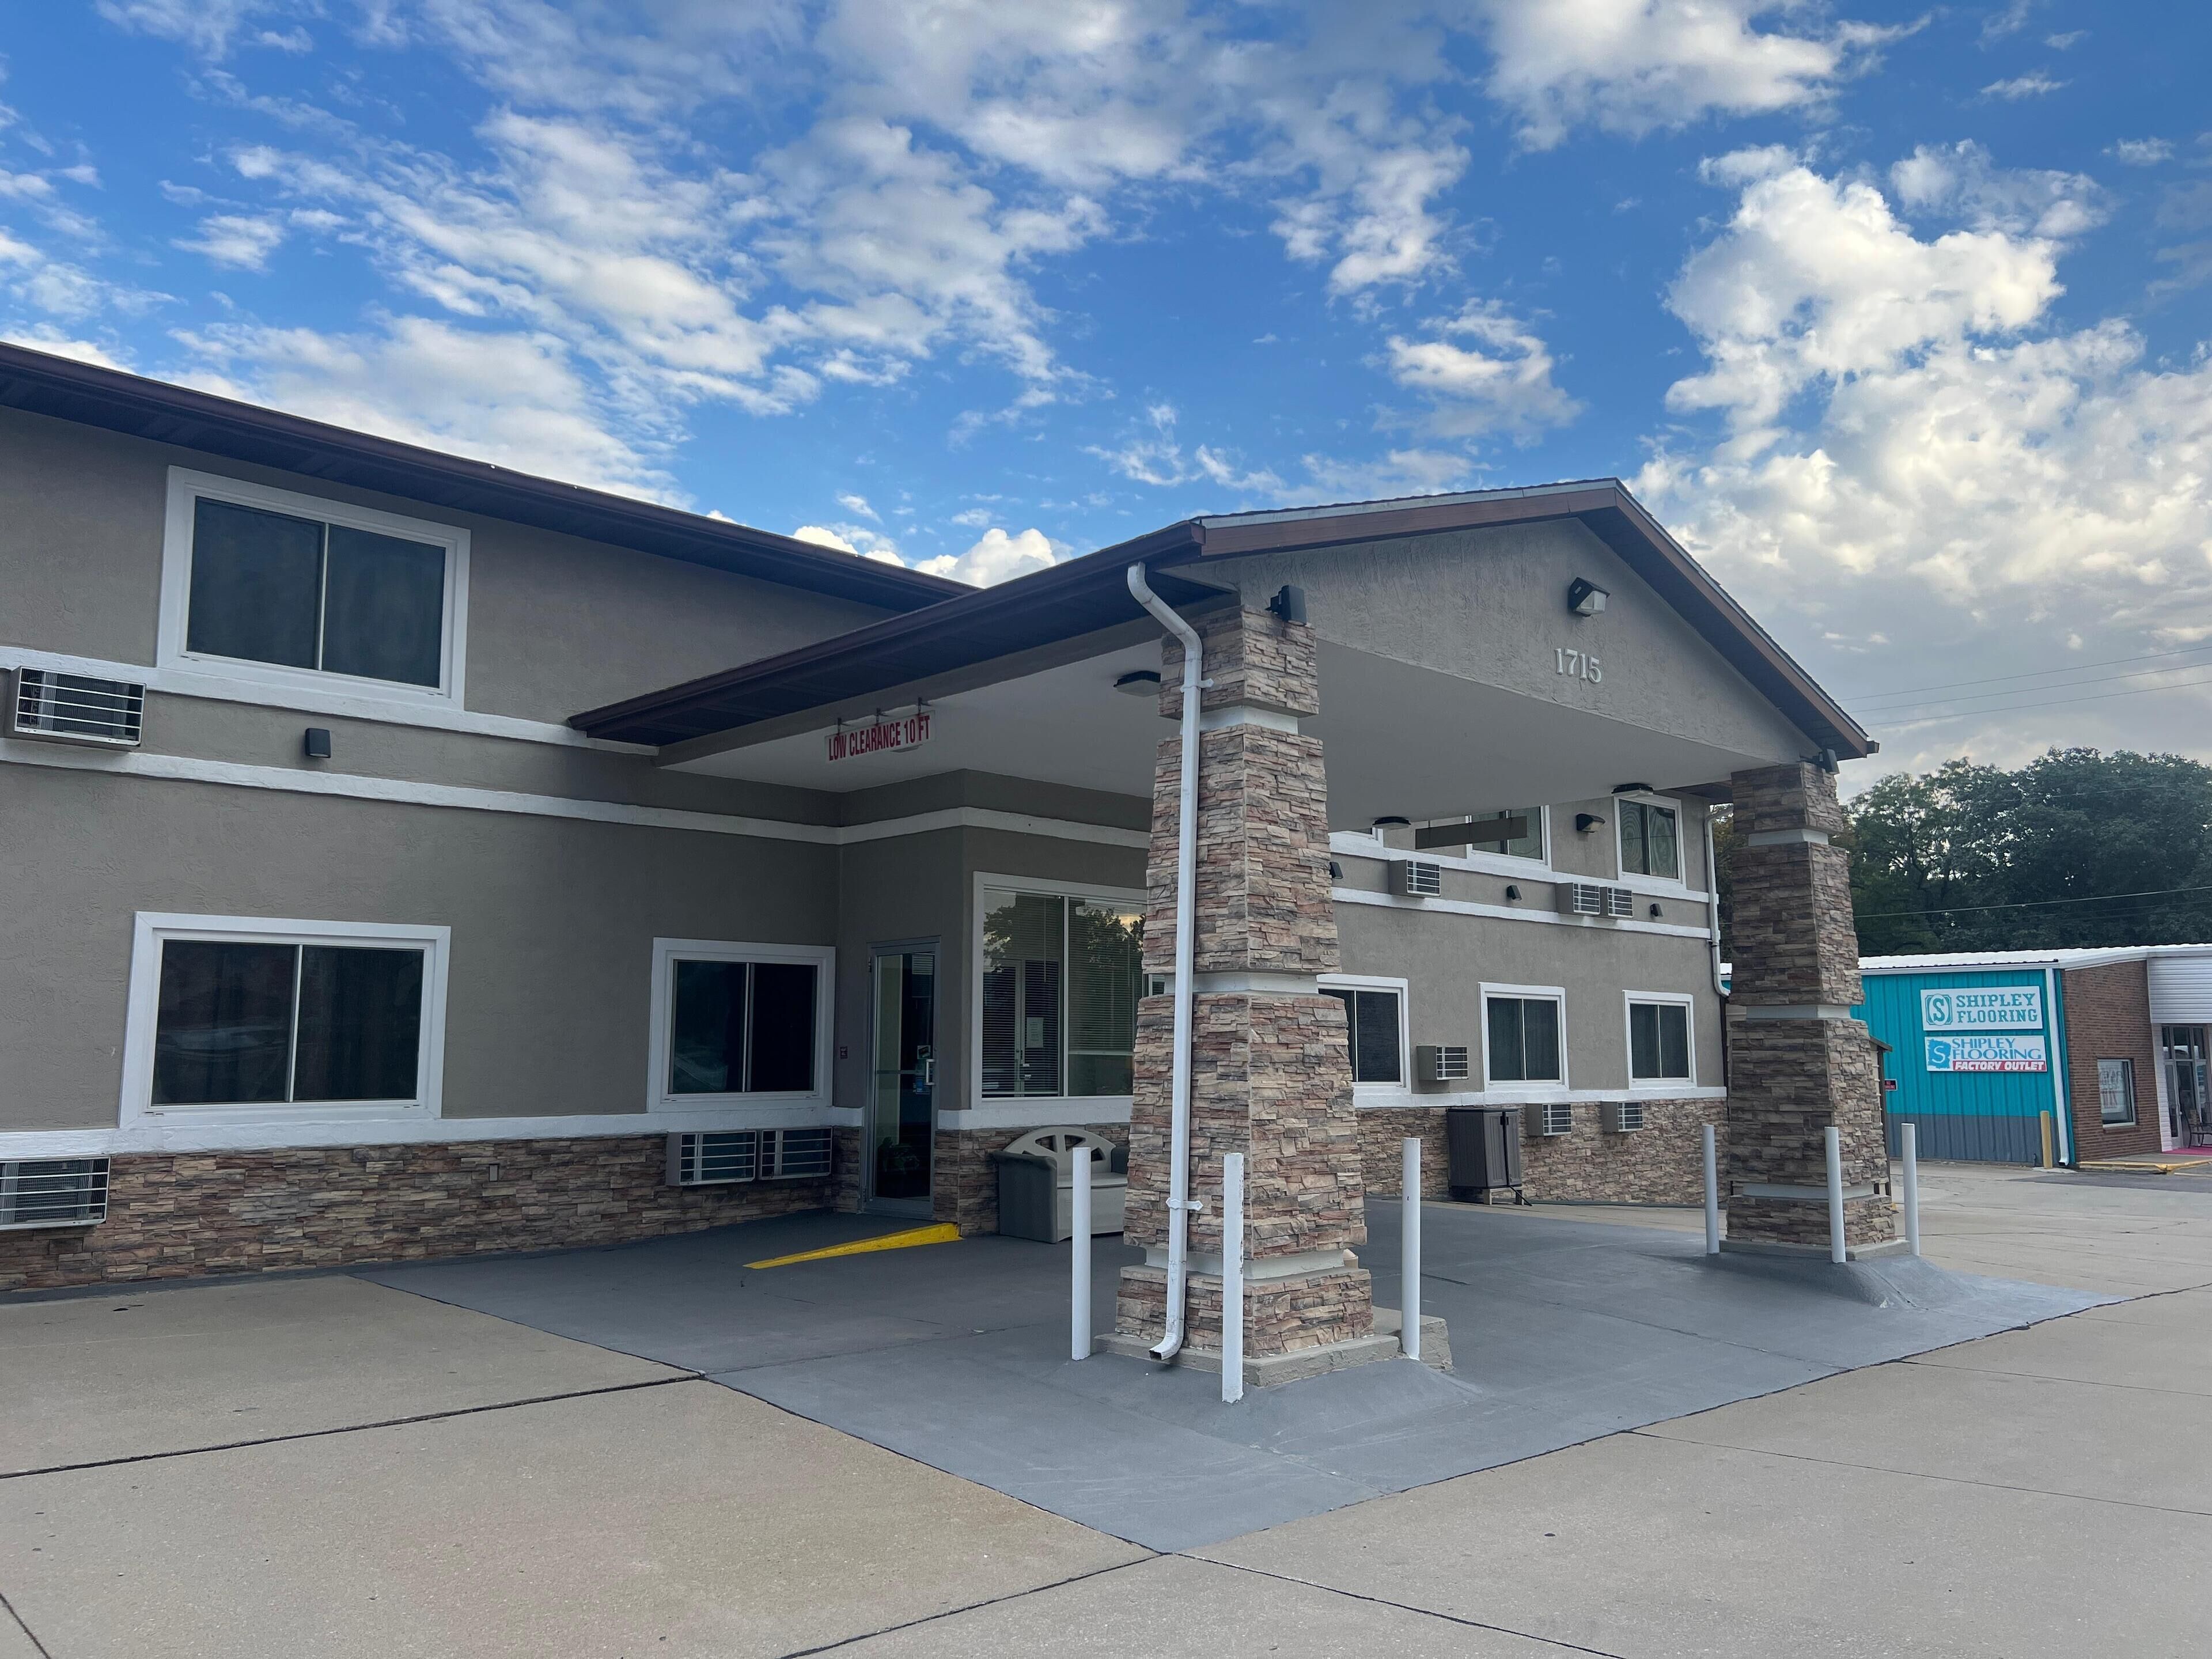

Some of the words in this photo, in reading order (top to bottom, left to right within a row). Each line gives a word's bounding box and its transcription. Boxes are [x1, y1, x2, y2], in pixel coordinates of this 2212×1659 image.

[1555, 648, 1602, 684] 1715
[829, 734, 847, 761] LOW
[850, 722, 901, 756] CLEARANCE
[904, 719, 916, 744] 10
[918, 715, 930, 741] FT
[1956, 993, 2036, 1007] SHIPLEY
[1932, 998, 1945, 1022] S
[1957, 1009, 2037, 1023] FLOORING
[1952, 1038, 2016, 1049] SHIPLEY
[1953, 1048, 2041, 1060] FLOORING
[1955, 1060, 2001, 1070] FACTORY
[2004, 1060, 2044, 1070] OUTLET
